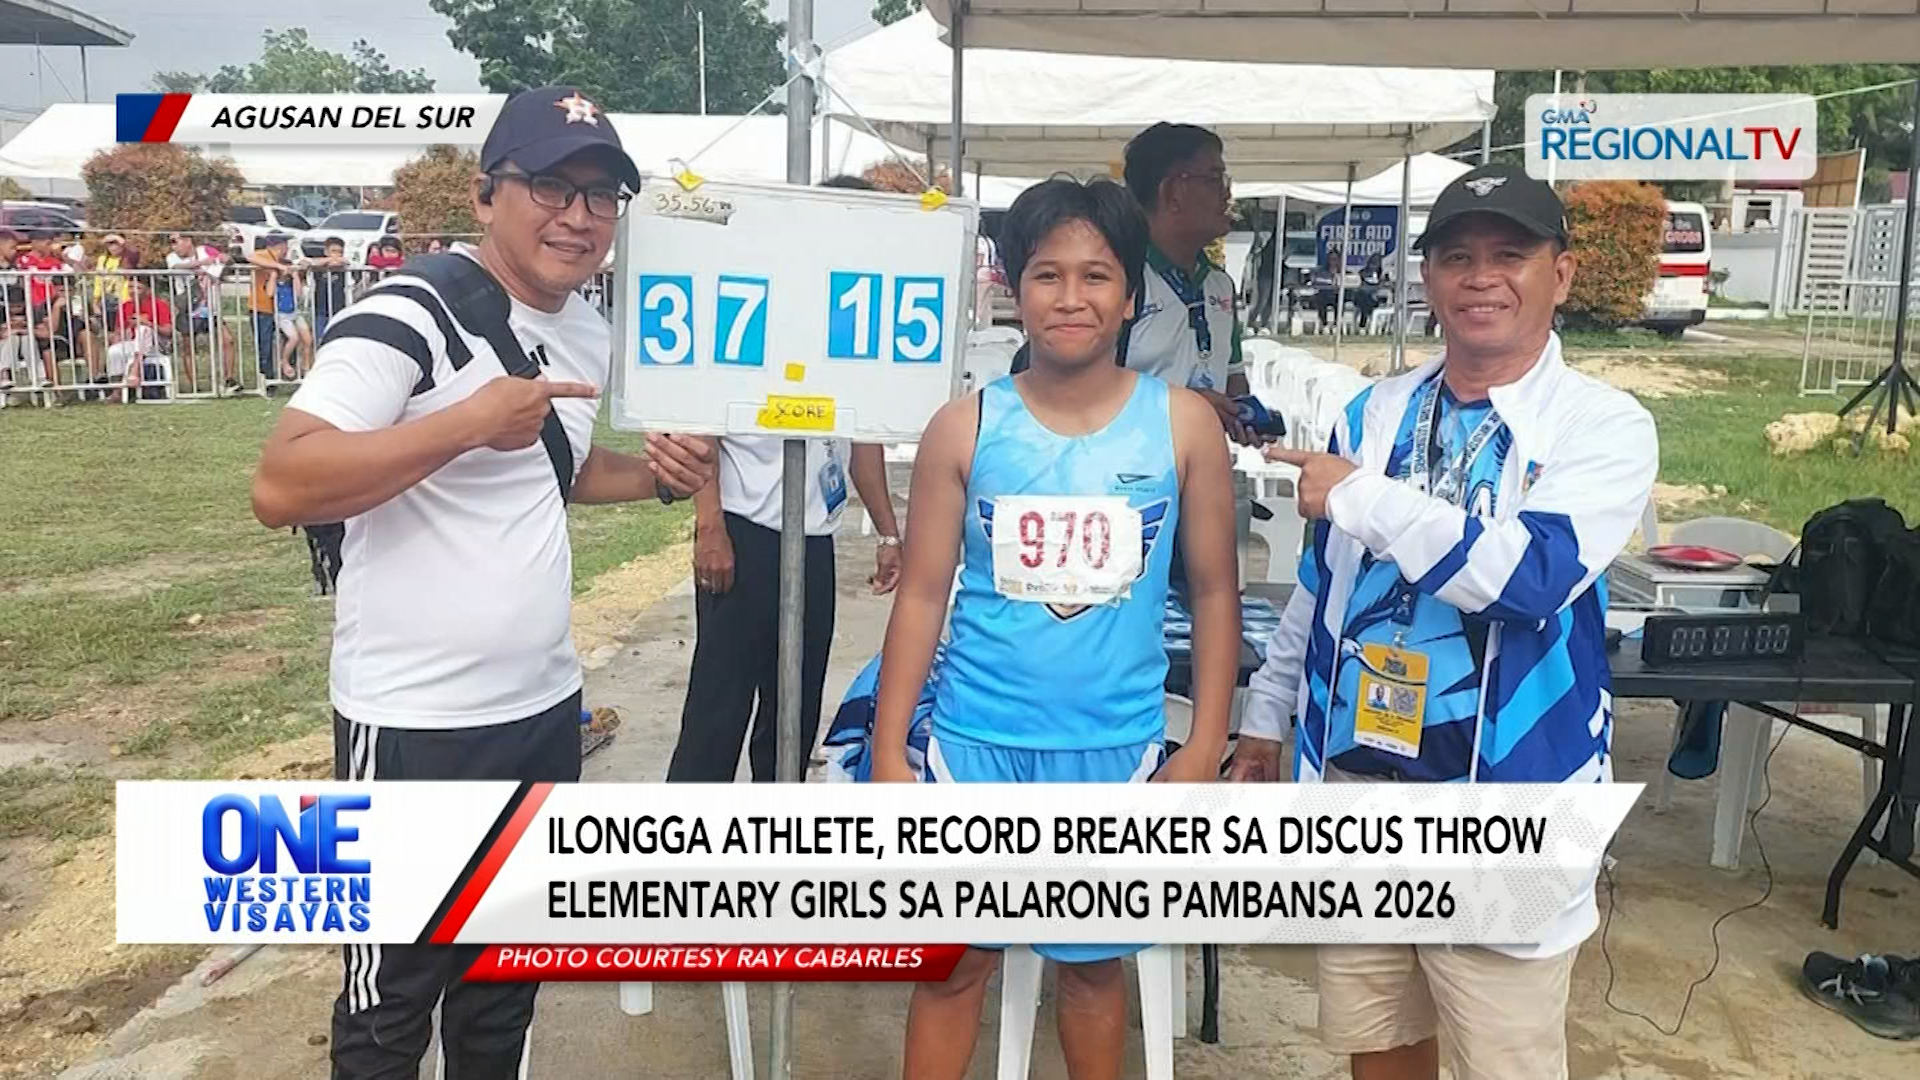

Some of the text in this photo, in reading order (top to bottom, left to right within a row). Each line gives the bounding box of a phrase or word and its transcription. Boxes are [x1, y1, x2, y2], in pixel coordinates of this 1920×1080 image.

[1365, 225, 1392, 240] AID
[774, 402, 826, 420] SCORE
[1019, 511, 1111, 570] 970
